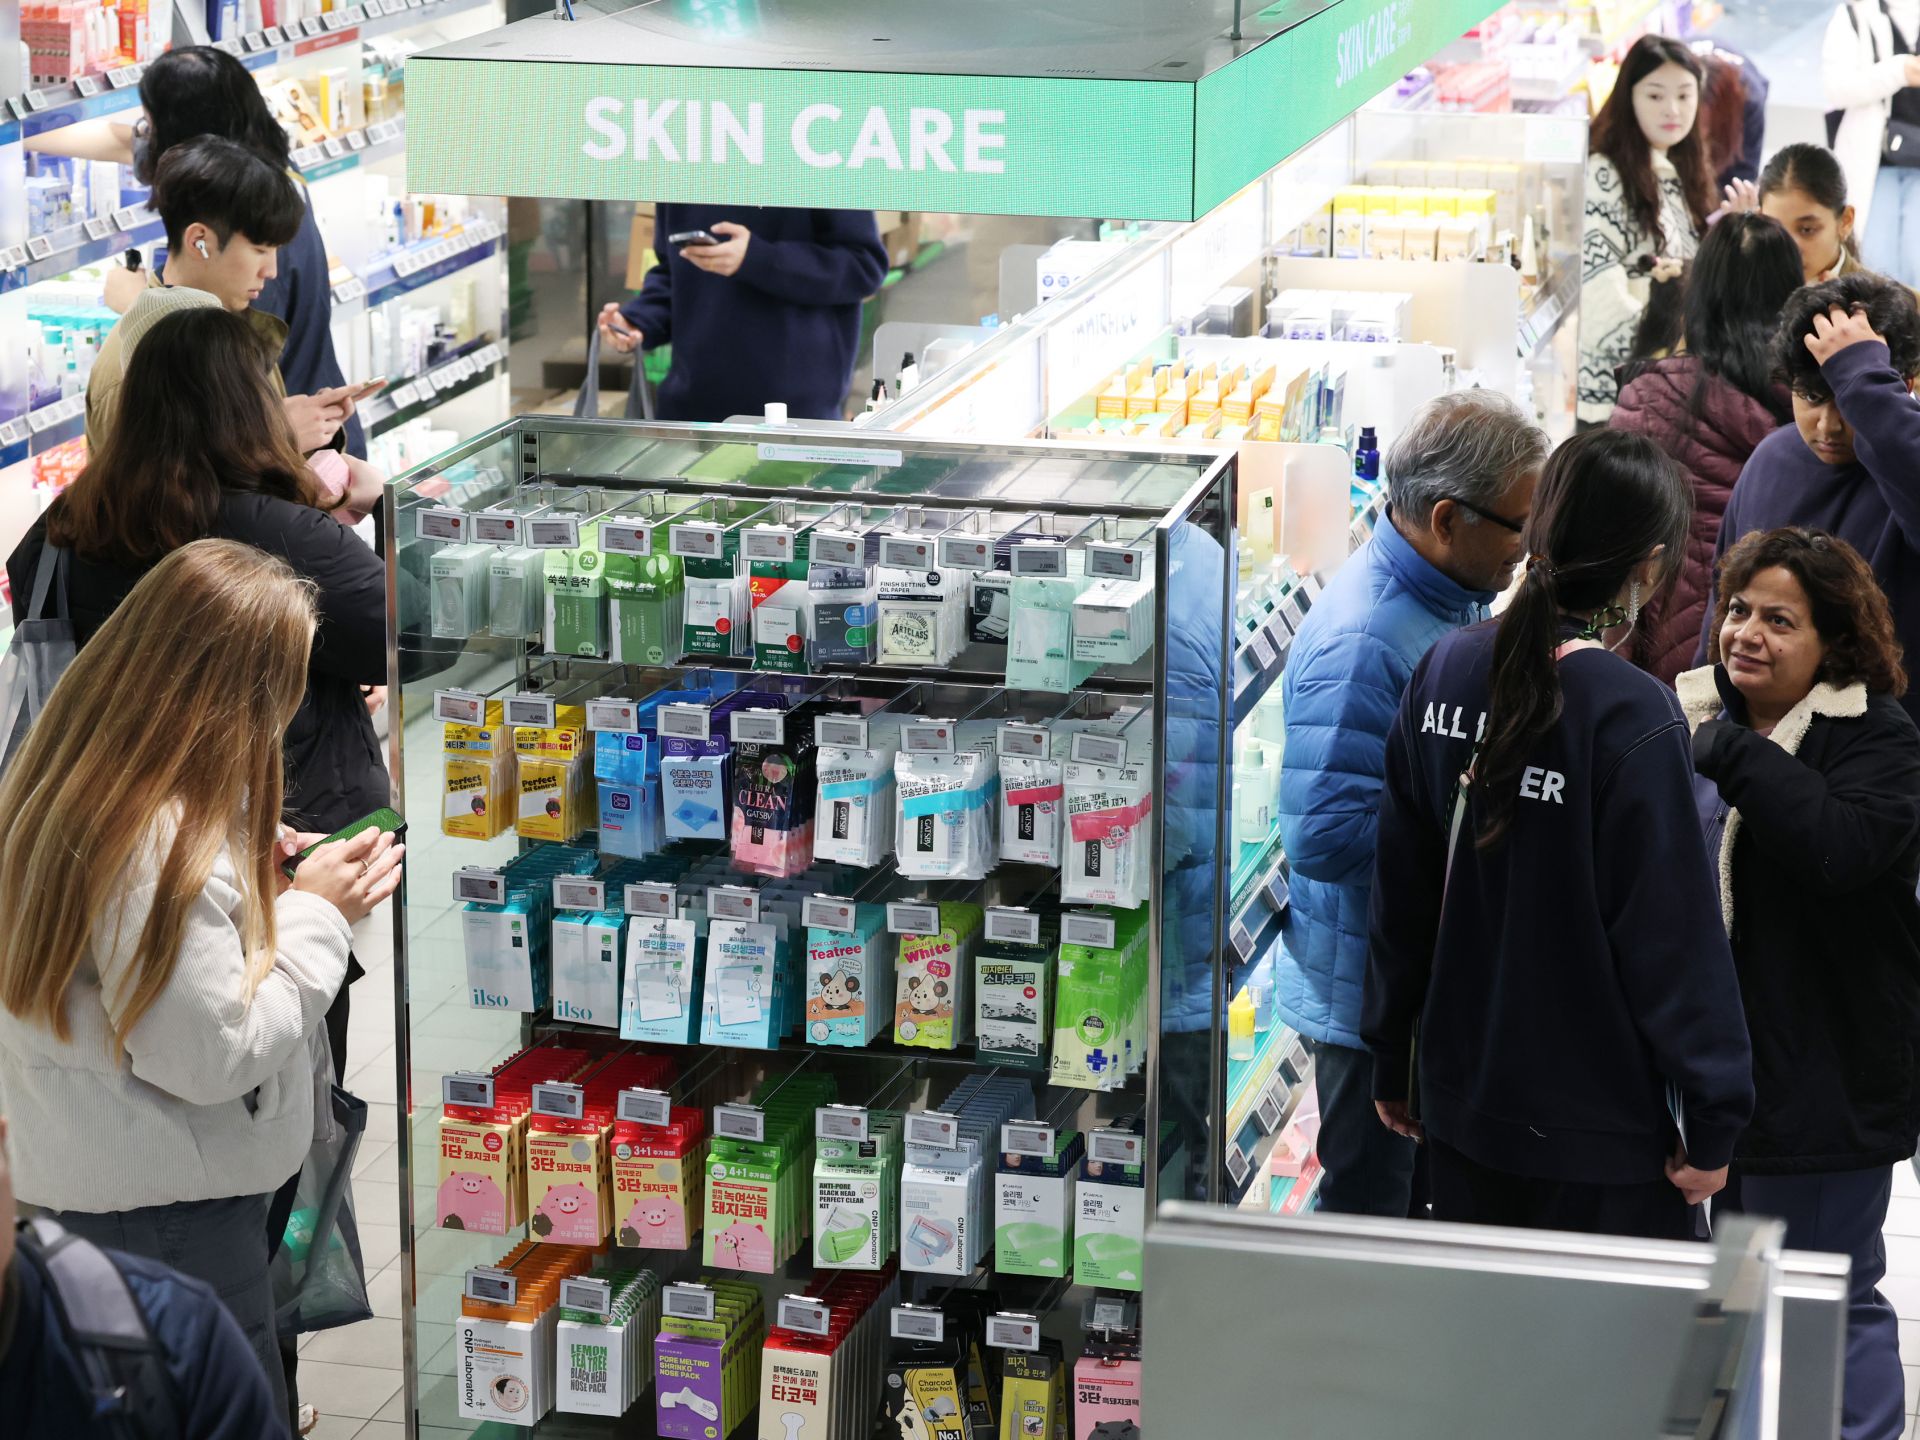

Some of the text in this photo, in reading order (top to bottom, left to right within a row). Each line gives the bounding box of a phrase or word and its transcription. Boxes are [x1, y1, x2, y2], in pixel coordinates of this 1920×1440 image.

[1336, 20, 1365, 88] SKIN
[1366, 1, 1397, 69] CARE
[581, 95, 1006, 174] SKIN CARE
[751, 582, 759, 592] 2
[1420, 701, 1467, 740] ALL
[448, 774, 482, 786] Perfect
[460, 782, 482, 790] Control
[522, 776, 557, 787] Perfect
[534, 783, 557, 791] Control
[1519, 765, 1566, 805] ER
[738, 789, 788, 811] CLEAN
[1068, 802, 1092, 814] 피지만
[1111, 796, 1127, 807] 제거
[746, 809, 773, 821] GATSBY
[840, 806, 848, 835] GATSBY
[1024, 807, 1032, 836] GATSBY
[924, 818, 933, 848] GATSBY
[1089, 843, 1098, 872] GATSBY
[809, 945, 862, 961] Teatree
[904, 943, 951, 964] White
[984, 973, 1036, 985] 소나무코팩
[473, 989, 509, 1007] ilso
[557, 1000, 593, 1021] ilso
[1053, 1056, 1059, 1069] 2
[442, 1144, 500, 1163] 1단 돼지코팩
[634, 1145, 651, 1156] 3+1
[531, 1157, 592, 1174] 3단 돼지코팩
[729, 1166, 747, 1178] 4+1
[617, 1178, 678, 1193] 3단 돼지코팩
[725, 1191, 768, 1206] 녹여쓰는
[1003, 1190, 1023, 1199] 슬리핑
[1003, 1199, 1016, 1207] 코팩
[1083, 1200, 1103, 1209] 슬리핑
[712, 1201, 768, 1220] 돼지코팩
[1083, 1208, 1096, 1217] 코팩
[870, 1229, 880, 1266] Laboratory
[956, 1236, 966, 1272] Laboratory
[571, 1343, 608, 1356] LEMON
[464, 1328, 475, 1409] CNP Laboratory
[572, 1354, 607, 1371] TEA TREE
[660, 1355, 710, 1368] PORE MELTING
[1008, 1357, 1027, 1368] 피지
[571, 1368, 607, 1383] BLACK HEAD
[660, 1369, 701, 1380] NOSE PACK
[773, 1365, 819, 1378] 블랙헤드&피지
[1033, 1369, 1046, 1378] 핀셋
[571, 1380, 607, 1394] NOSE PACK
[773, 1374, 818, 1388] 한 번에 올킬!
[918, 1379, 953, 1387] Charcoal
[772, 1385, 817, 1406] 타코팩
[1079, 1391, 1101, 1405] 3단
[938, 1431, 961, 1440] No.1
